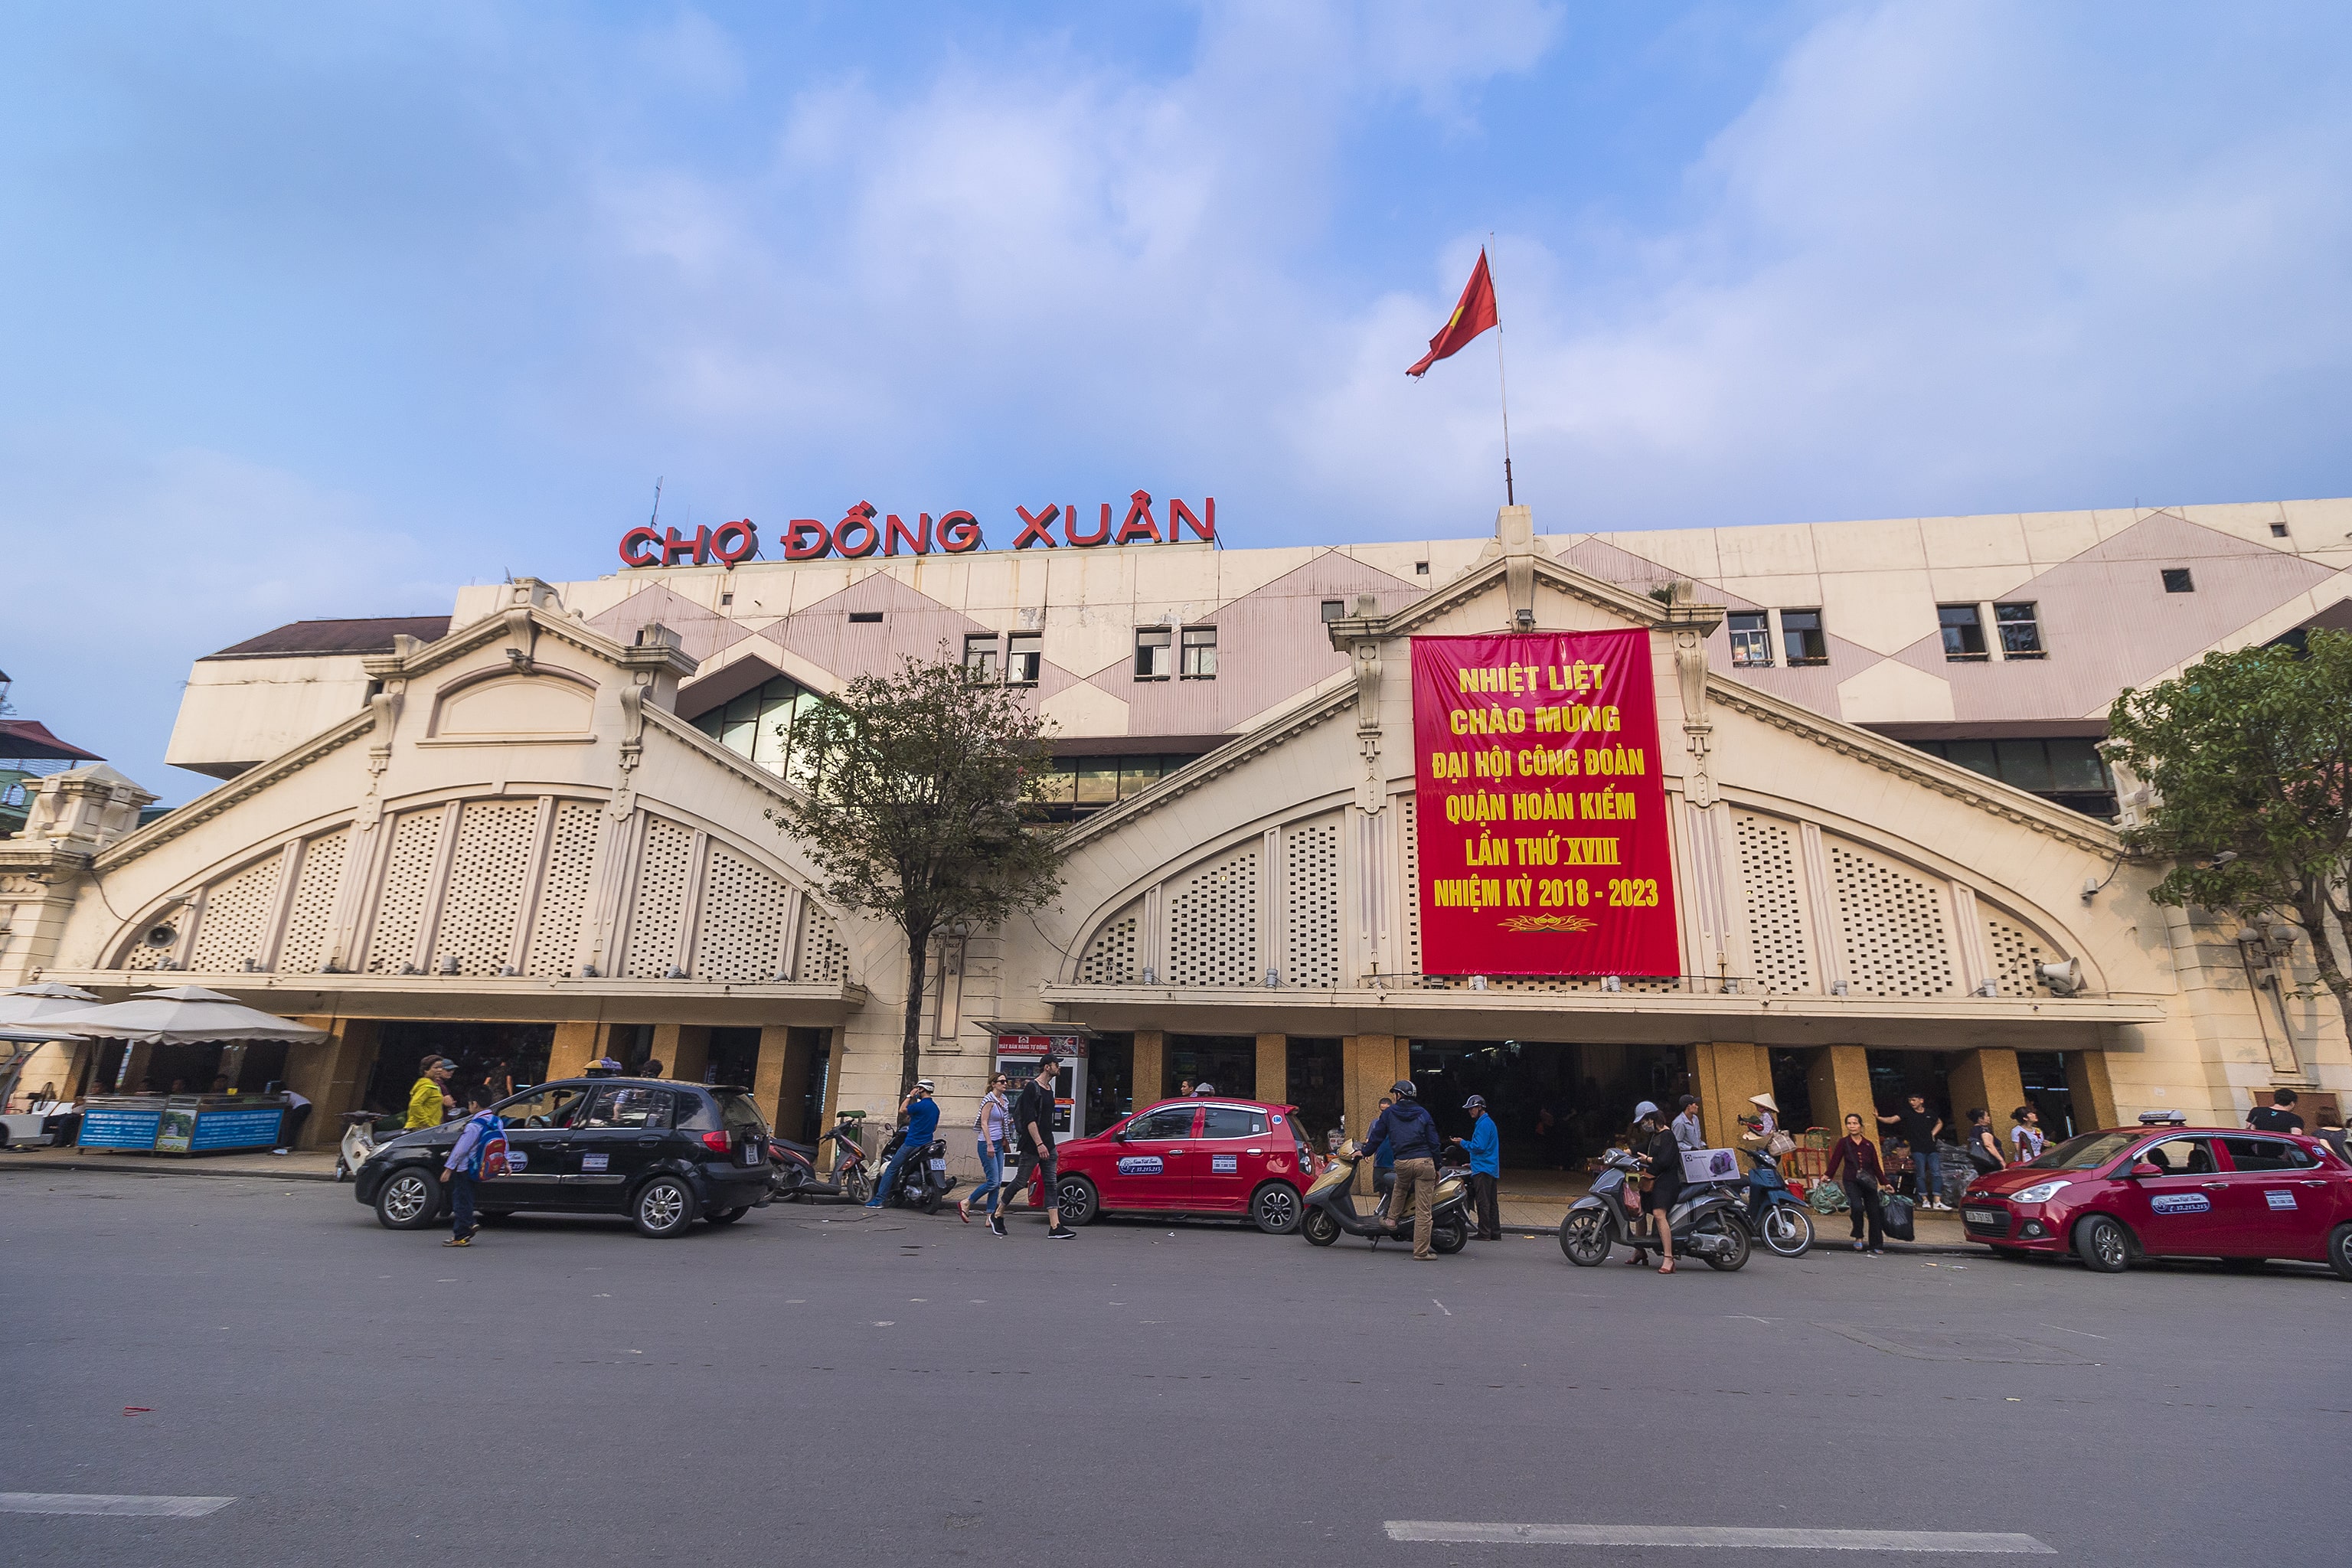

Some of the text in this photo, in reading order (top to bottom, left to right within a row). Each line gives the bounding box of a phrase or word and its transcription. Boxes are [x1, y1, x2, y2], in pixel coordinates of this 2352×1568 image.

[619, 488, 1215, 570] CHỢ ĐỒNG XUÂN
[1459, 659, 1605, 697] NHIỆT LIỆT
[1450, 700, 1621, 736] CHÀO MỪNG
[1432, 743, 1645, 784] ĐẠI HỘI CÔNG ĐOÀN
[1446, 783, 1636, 827] QUẬN HOÀN KIẾM
[1465, 829, 1621, 866] LẦN THỨ XVIII
[1434, 873, 1500, 913] NHIỆM
[1507, 874, 1532, 906] KỲ
[1539, 878, 1589, 906] 2018
[1609, 878, 1658, 906] 2023
